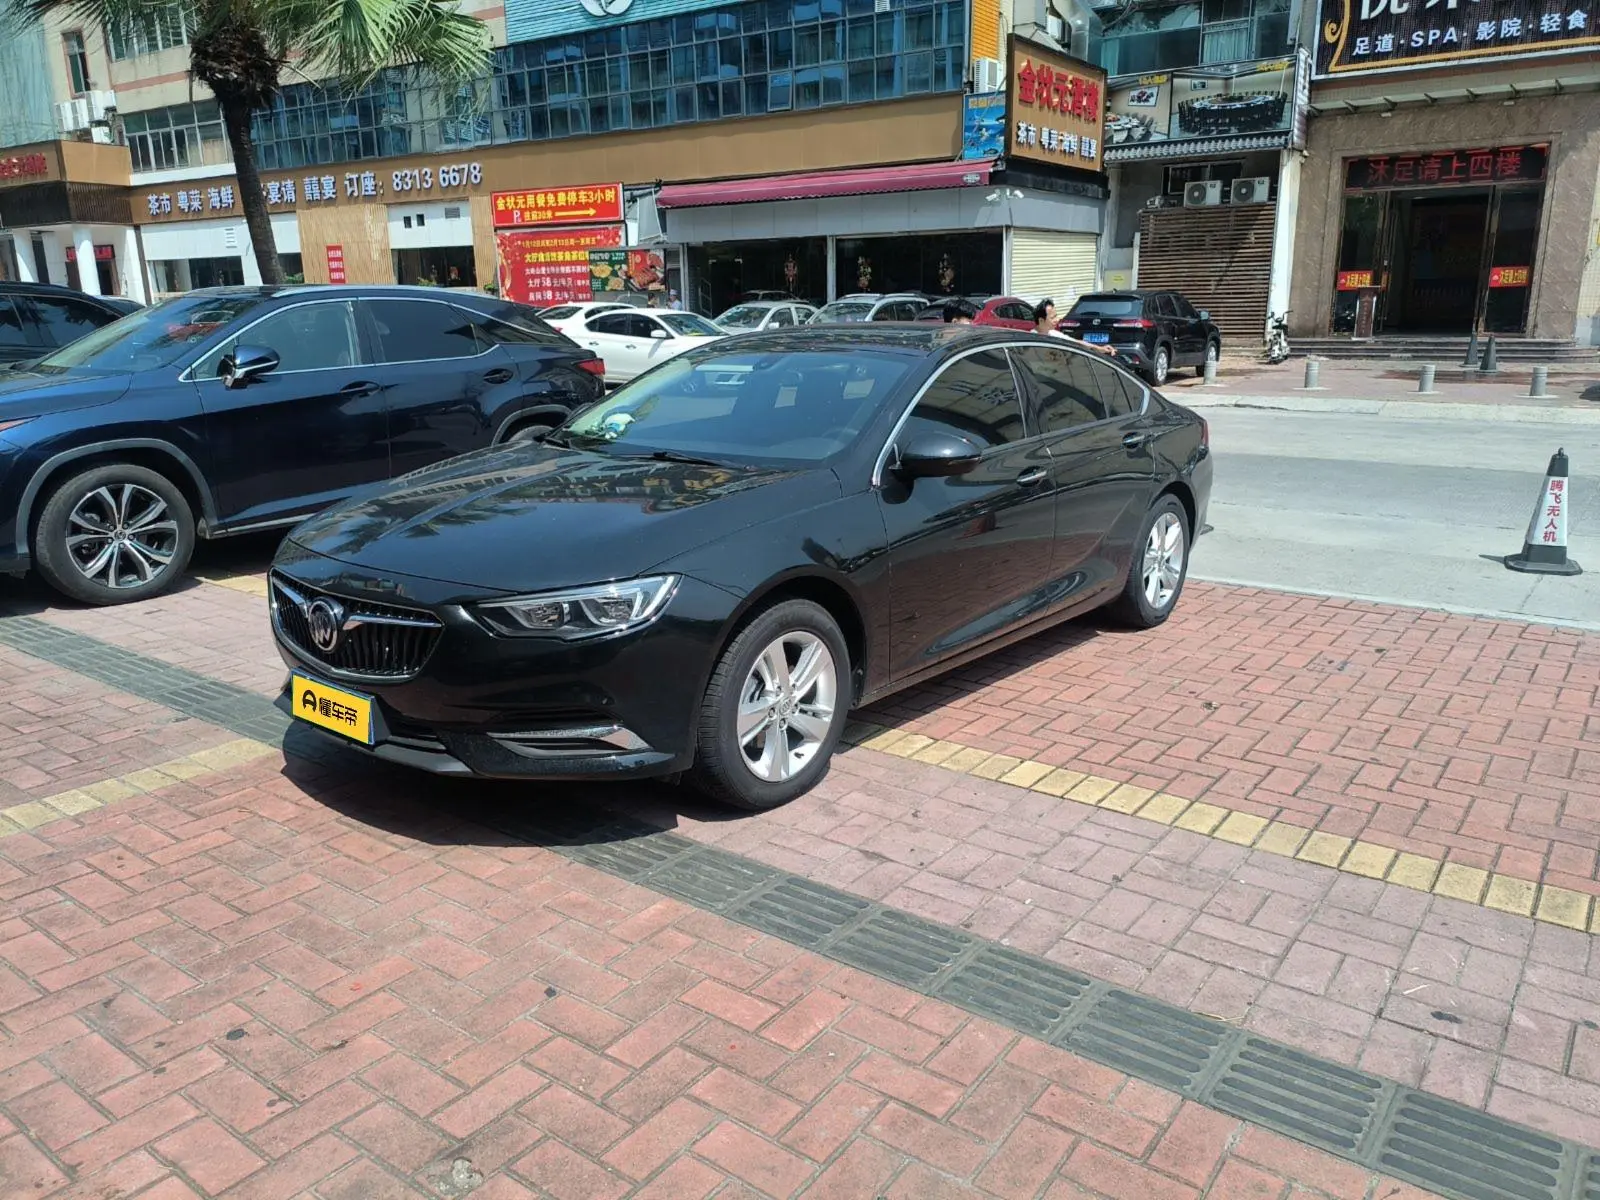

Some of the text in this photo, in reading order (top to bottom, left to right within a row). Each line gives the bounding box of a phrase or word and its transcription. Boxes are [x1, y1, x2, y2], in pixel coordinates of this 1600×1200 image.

[1018, 59, 1099, 122] 金状元酒楼
[1018, 121, 1037, 145] 茶市
[1041, 127, 1058, 150] 粤菜
[147, 192, 171, 215] 茶市
[177, 189, 203, 212] 粤菜
[208, 185, 234, 210] 海鲜
[261, 179, 296, 205] 宴请
[392, 168, 433, 191] 8313
[438, 162, 482, 188] 6678
[496, 188, 616, 211] 金状元用餐免费停车3小时
[1543, 480, 1564, 542] 腾飞无人机
